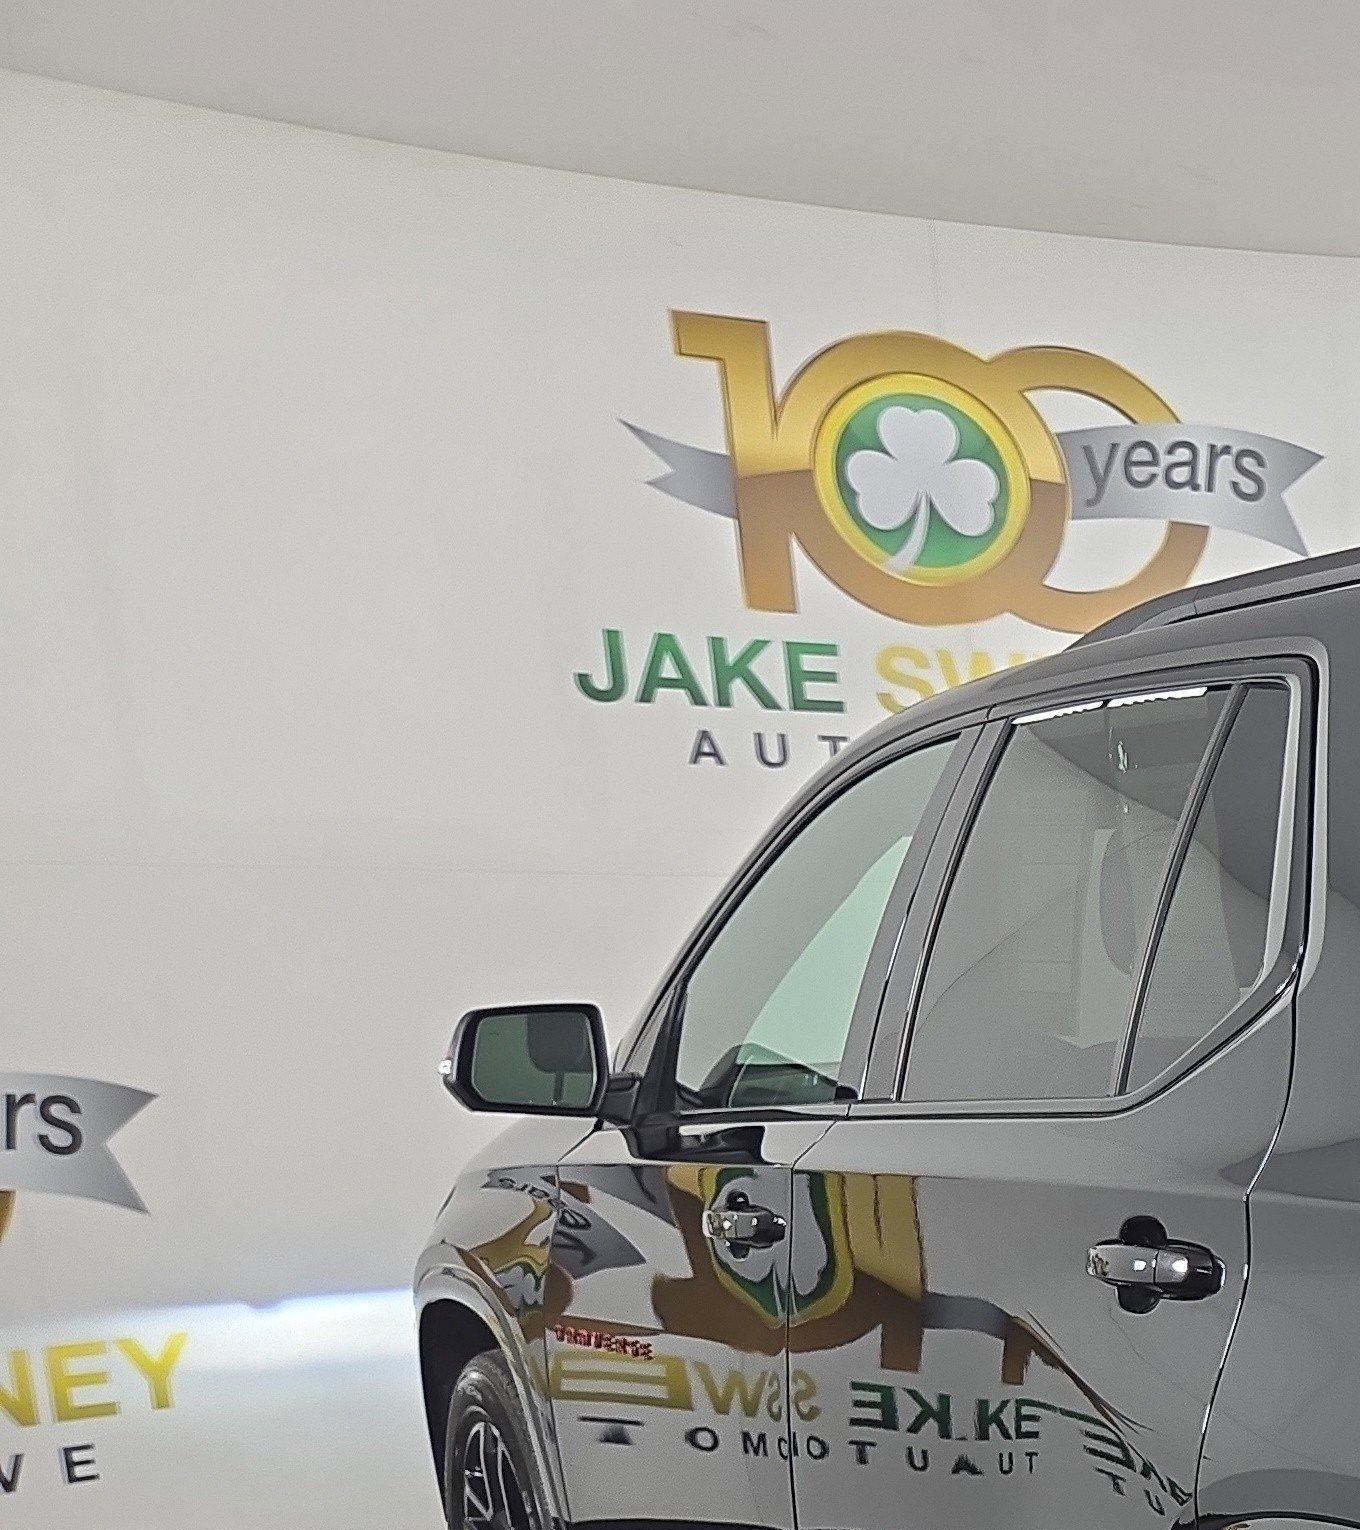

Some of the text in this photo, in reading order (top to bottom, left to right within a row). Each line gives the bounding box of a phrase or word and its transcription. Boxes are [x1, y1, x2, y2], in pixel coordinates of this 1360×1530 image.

[1081, 437, 1269, 506] years
[573, 627, 848, 714] JAKE
[5, 1092, 83, 1156] rs
